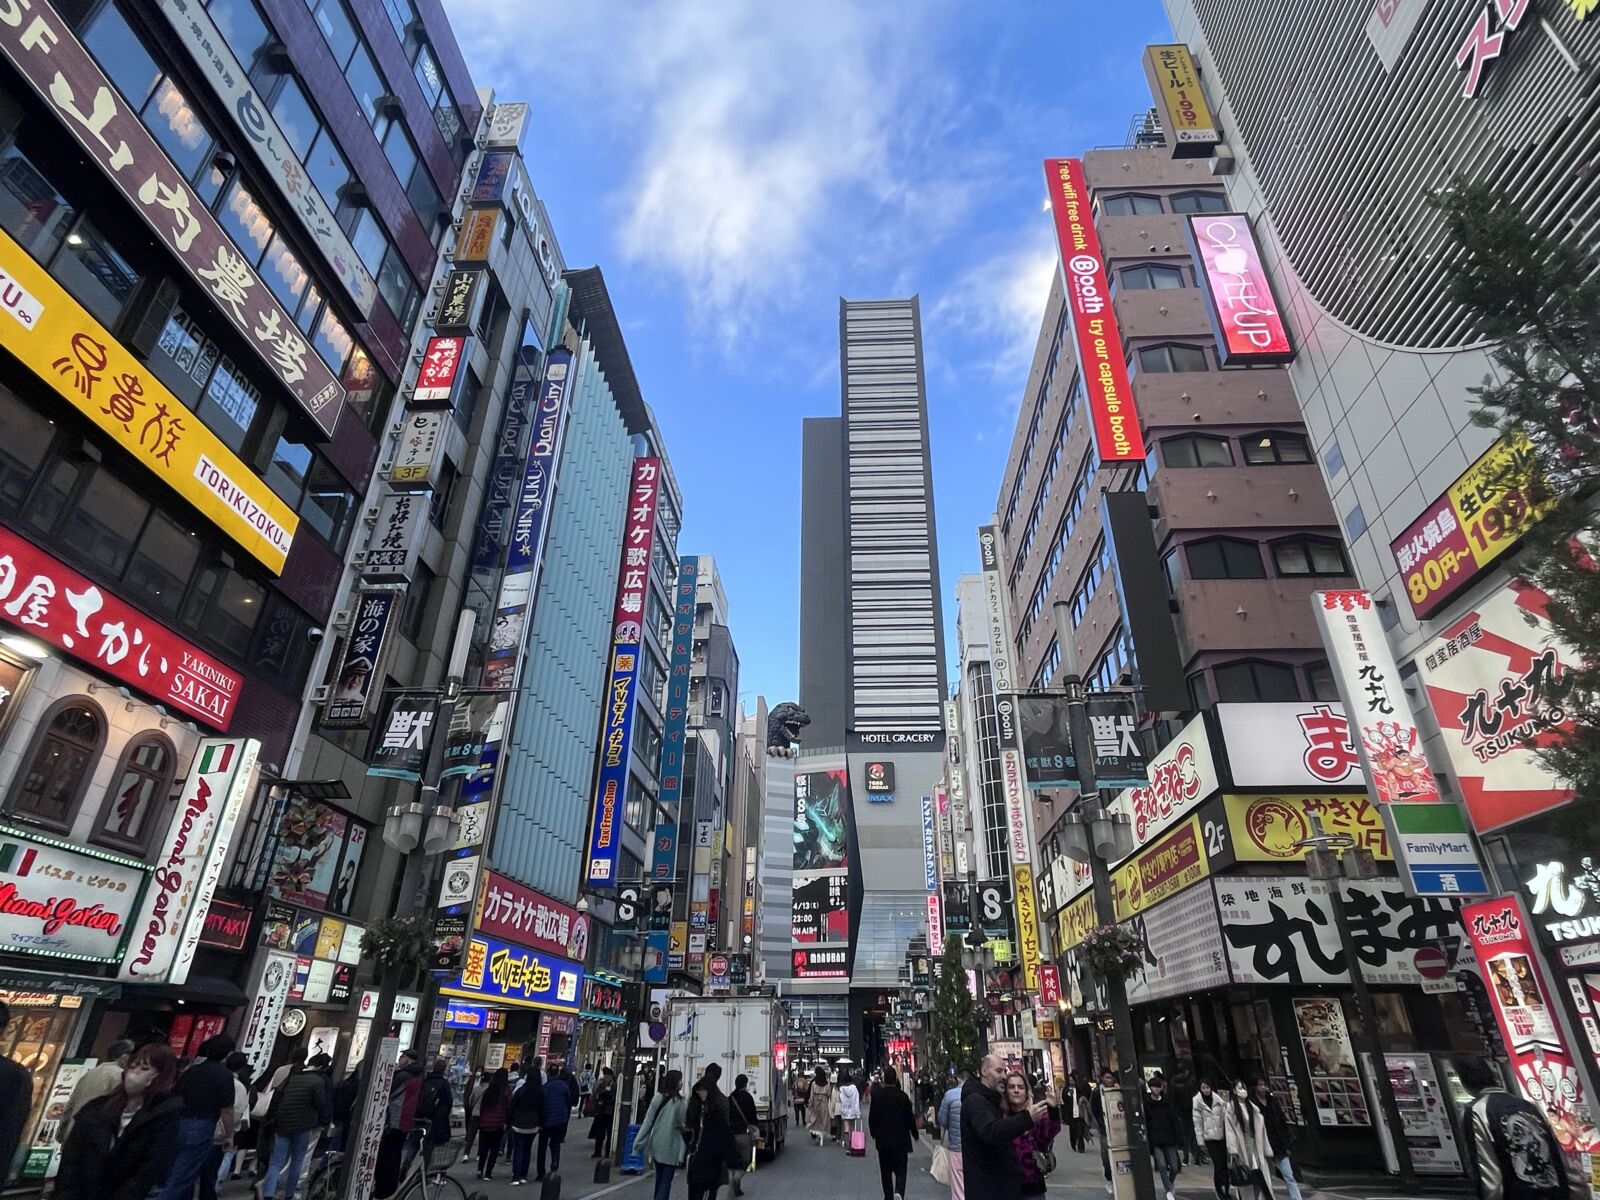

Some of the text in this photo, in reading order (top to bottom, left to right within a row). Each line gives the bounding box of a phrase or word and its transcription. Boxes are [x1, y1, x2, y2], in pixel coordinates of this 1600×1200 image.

[1160, 51, 1185, 88] 生ビール
[50, 71, 306, 383] 山内農場
[1066, 201, 1080, 222] free
[1071, 223, 1088, 250] drink
[444, 272, 473, 317] 山内農場
[1069, 255, 1101, 314] Booth
[423, 352, 441, 386] さかい
[1090, 319, 1131, 455] try our capsule booth
[52, 332, 186, 468] 鳥貴族
[424, 389, 440, 400] 4F
[401, 467, 421, 479] 3F
[516, 382, 566, 542] SHINJUKU Plain City
[200, 457, 284, 545] TORIKIZOKU
[380, 497, 411, 549] お好み焼
[621, 463, 656, 613] カラオケ歌広場
[1396, 507, 1458, 574] 炭火焼鳥
[367, 550, 405, 566] 大阪家
[980, 533, 996, 566] Booth
[353, 599, 385, 654] 海の家
[987, 574, 999, 614] ネットカフェ
[993, 626, 1003, 654] カプセル
[617, 655, 634, 671] 薬
[1425, 622, 1482, 672] 個室居酒屋
[181, 651, 237, 693] YAKINIKU
[1358, 664, 1395, 716] 九十九
[170, 673, 230, 719] SAKAI
[382, 711, 434, 750] 獣
[606, 677, 632, 767] マツモトキヨシ
[861, 734, 935, 743] HOTEL GRACERY
[998, 701, 1013, 740] Booth
[1089, 715, 1141, 757] 獣
[604, 779, 617, 806] Shop
[867, 794, 895, 803] IMAX
[1130, 741, 1202, 844] まねきねこ
[168, 776, 213, 867] Miami
[351, 828, 365, 843] 2F
[1205, 821, 1226, 857] 2F
[924, 828, 935, 886] カラオケランド
[1406, 842, 1469, 855] FamilyMart
[1039, 879, 1052, 913] 3F
[1221, 882, 1307, 906] 築地海鮮
[1438, 873, 1460, 891] 酒
[1526, 861, 1586, 917] 九
[484, 886, 570, 946] カラオケ歌広場
[792, 914, 813, 923] 23:00
[801, 926, 814, 935] AIR
[929, 906, 943, 956] 新宿東宝ビル
[1473, 908, 1520, 937] 九十九
[1018, 885, 1039, 988] やきとりセンター
[1479, 932, 1517, 946] TSUKUMO
[463, 946, 485, 984] 薬
[490, 949, 551, 997] マツモトキヨシ
[810, 952, 846, 964] MARUHAN
[1045, 978, 1057, 1001] 焼肉
